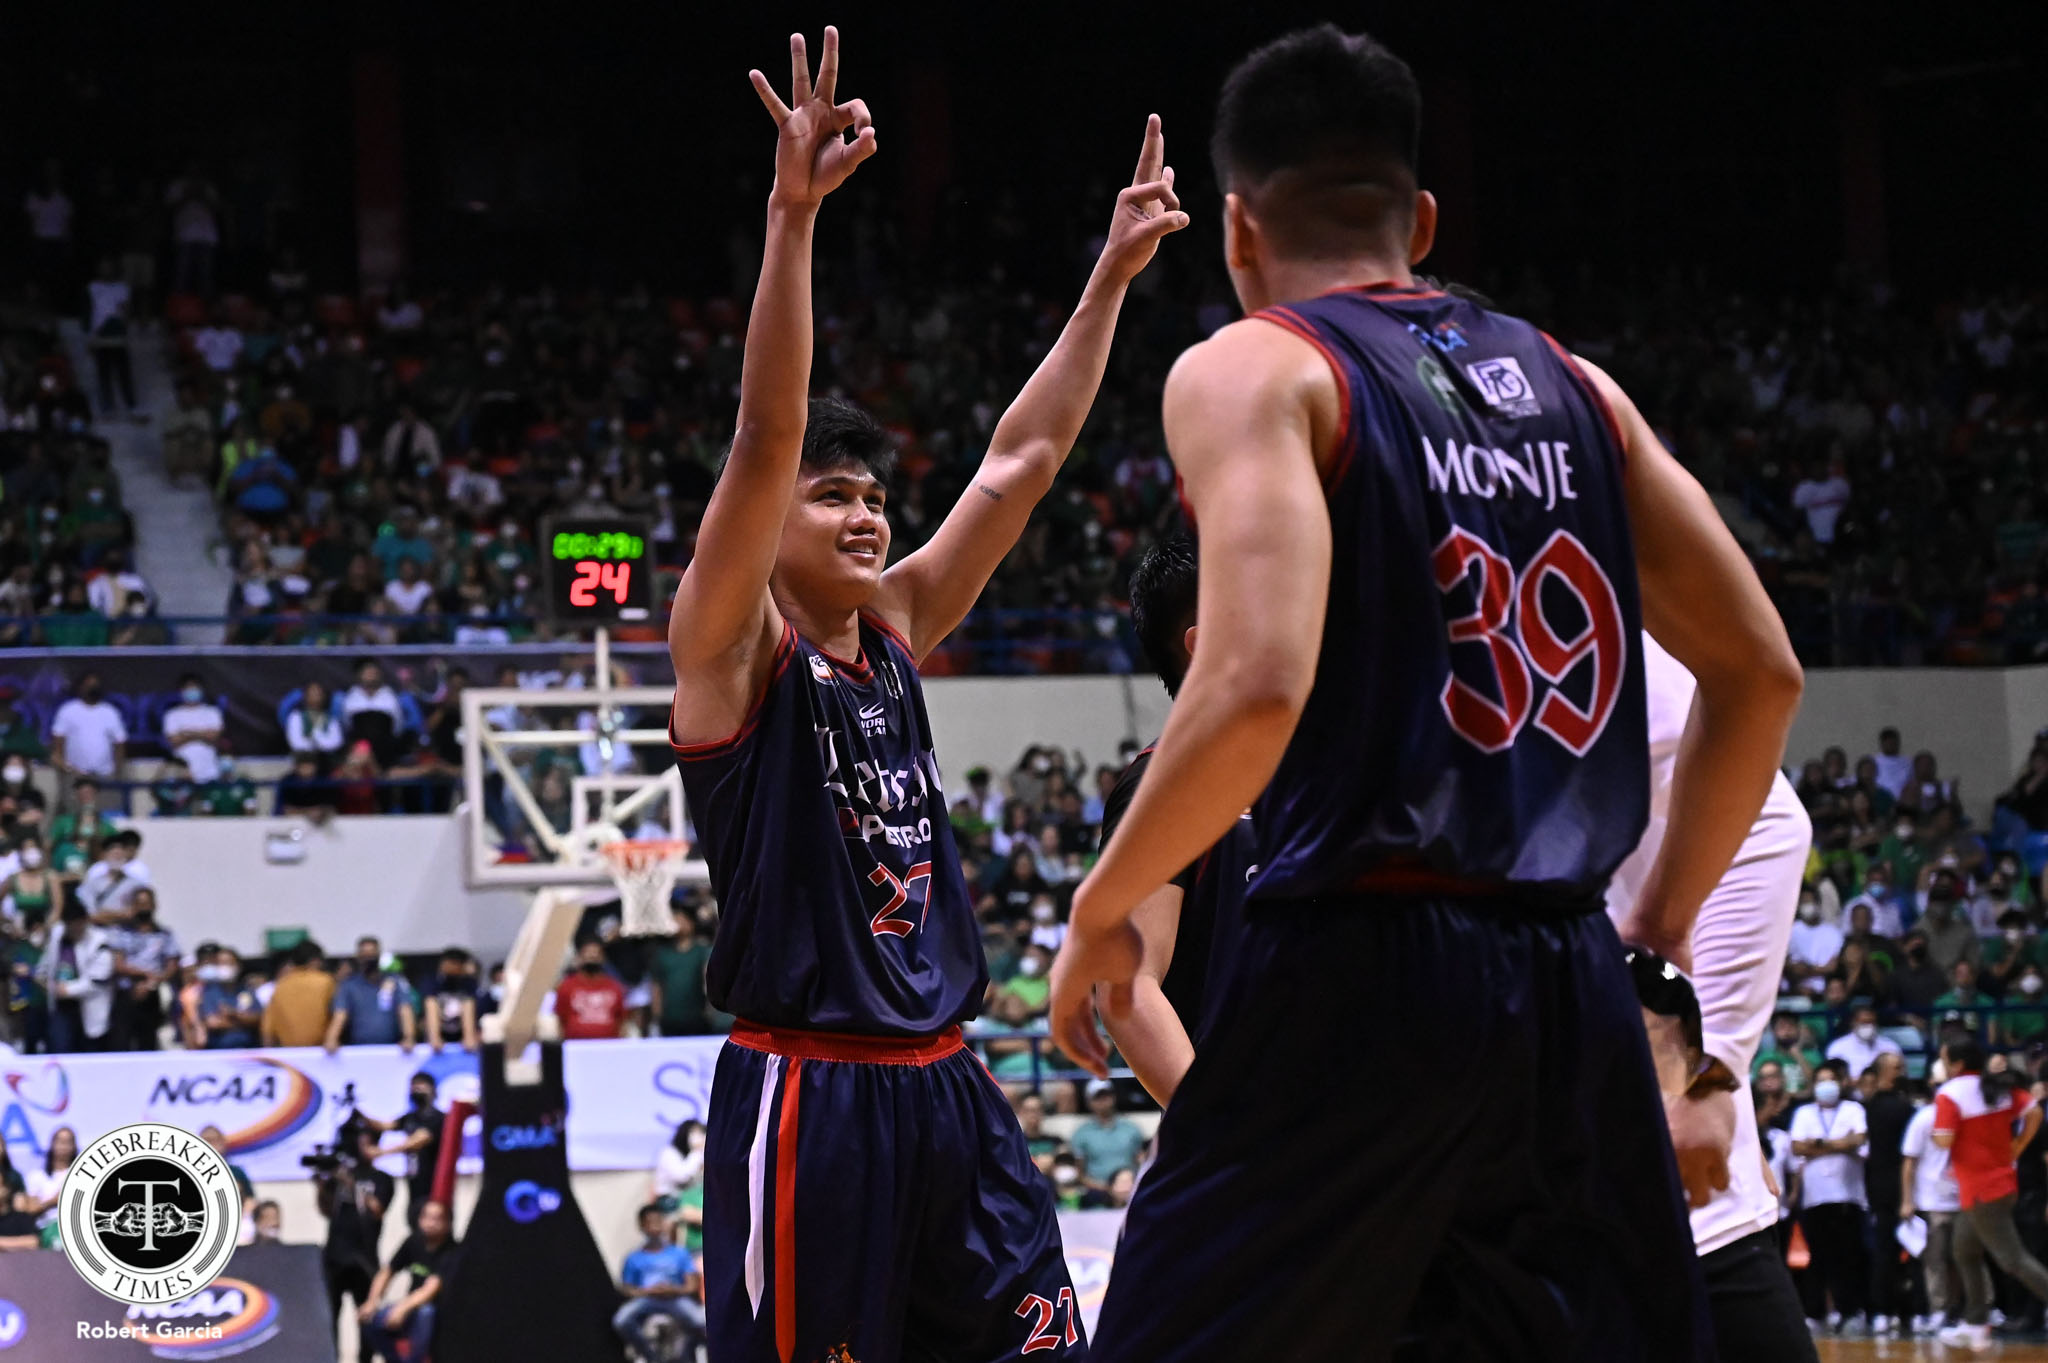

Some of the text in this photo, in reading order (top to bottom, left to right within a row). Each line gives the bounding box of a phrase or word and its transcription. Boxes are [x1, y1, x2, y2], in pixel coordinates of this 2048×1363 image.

[1421, 436, 1578, 511] MONJE
[570, 561, 631, 607] 24
[1430, 523, 1627, 758] 39
[867, 860, 932, 938] 27
[149, 1075, 276, 1104] NCAA
[1014, 1286, 1079, 1355] 27
